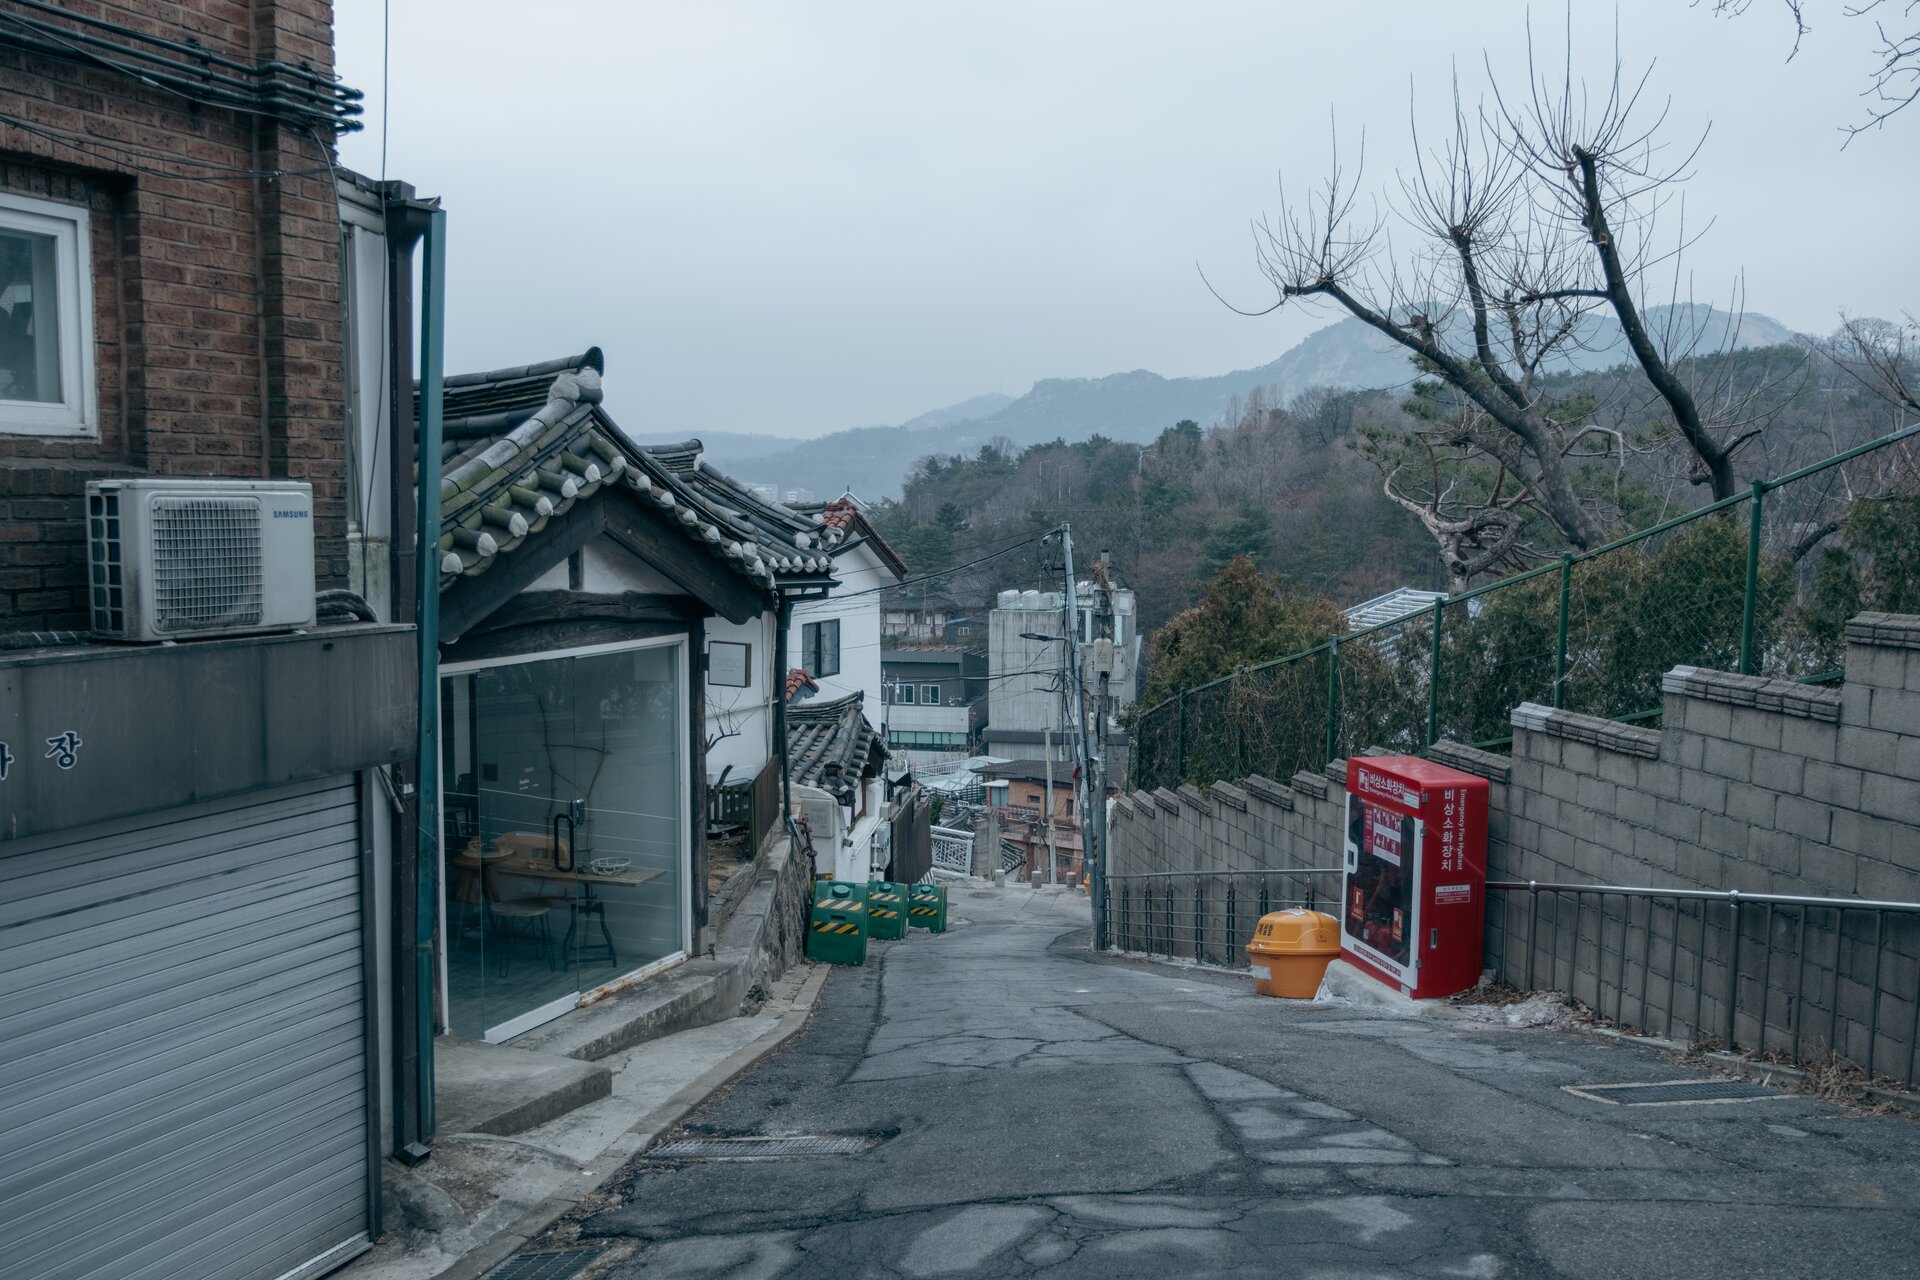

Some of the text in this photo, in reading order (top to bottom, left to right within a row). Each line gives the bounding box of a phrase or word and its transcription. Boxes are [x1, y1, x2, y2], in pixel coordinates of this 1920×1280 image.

[273, 510, 309, 519] SAMSUNG
[1369, 773, 1405, 796] 비상소화장치
[1458, 788, 1467, 828] Emergency
[1456, 842, 1465, 871] Hydrant
